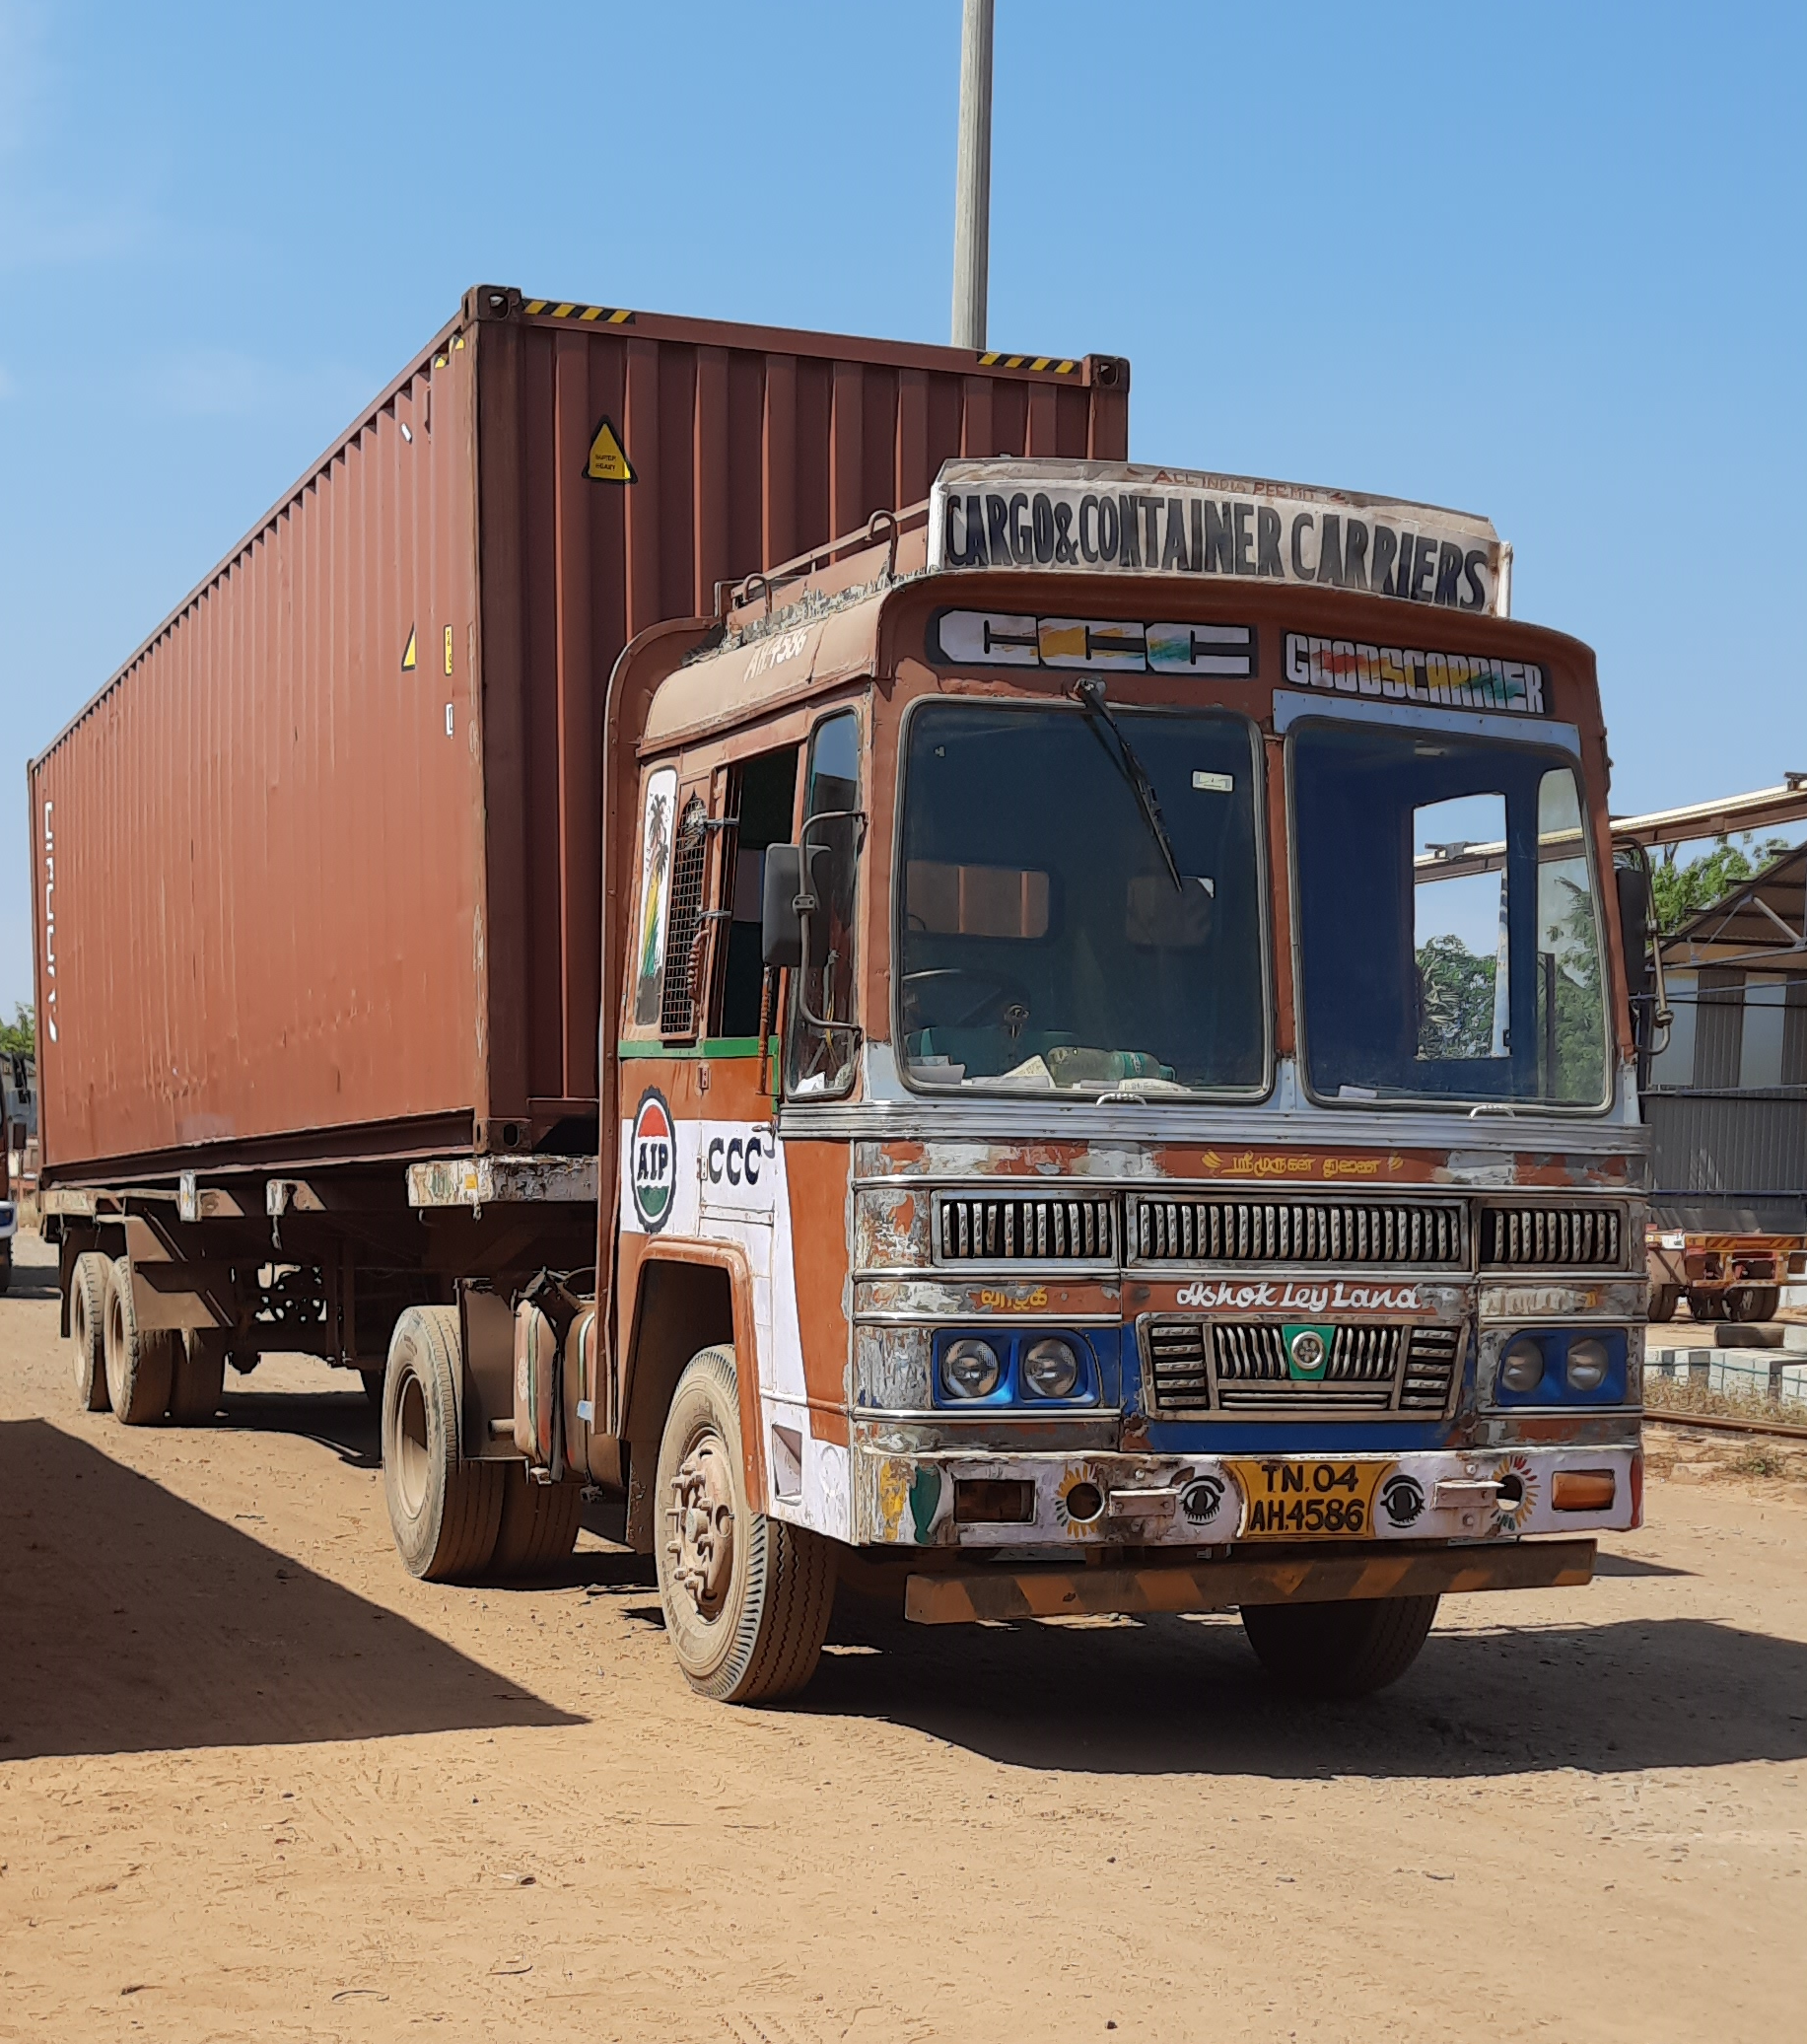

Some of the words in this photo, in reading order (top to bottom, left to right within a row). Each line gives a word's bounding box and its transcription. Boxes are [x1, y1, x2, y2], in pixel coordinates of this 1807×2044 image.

[1151, 469, 1195, 485] ALL
[1290, 511, 1490, 612] CARRIERS
[938, 608, 1252, 675] CCC
[637, 1143, 667, 1180] AIP
[1176, 1281, 1278, 1308] Ashok
[1262, 1464, 1358, 1493] TN.04
